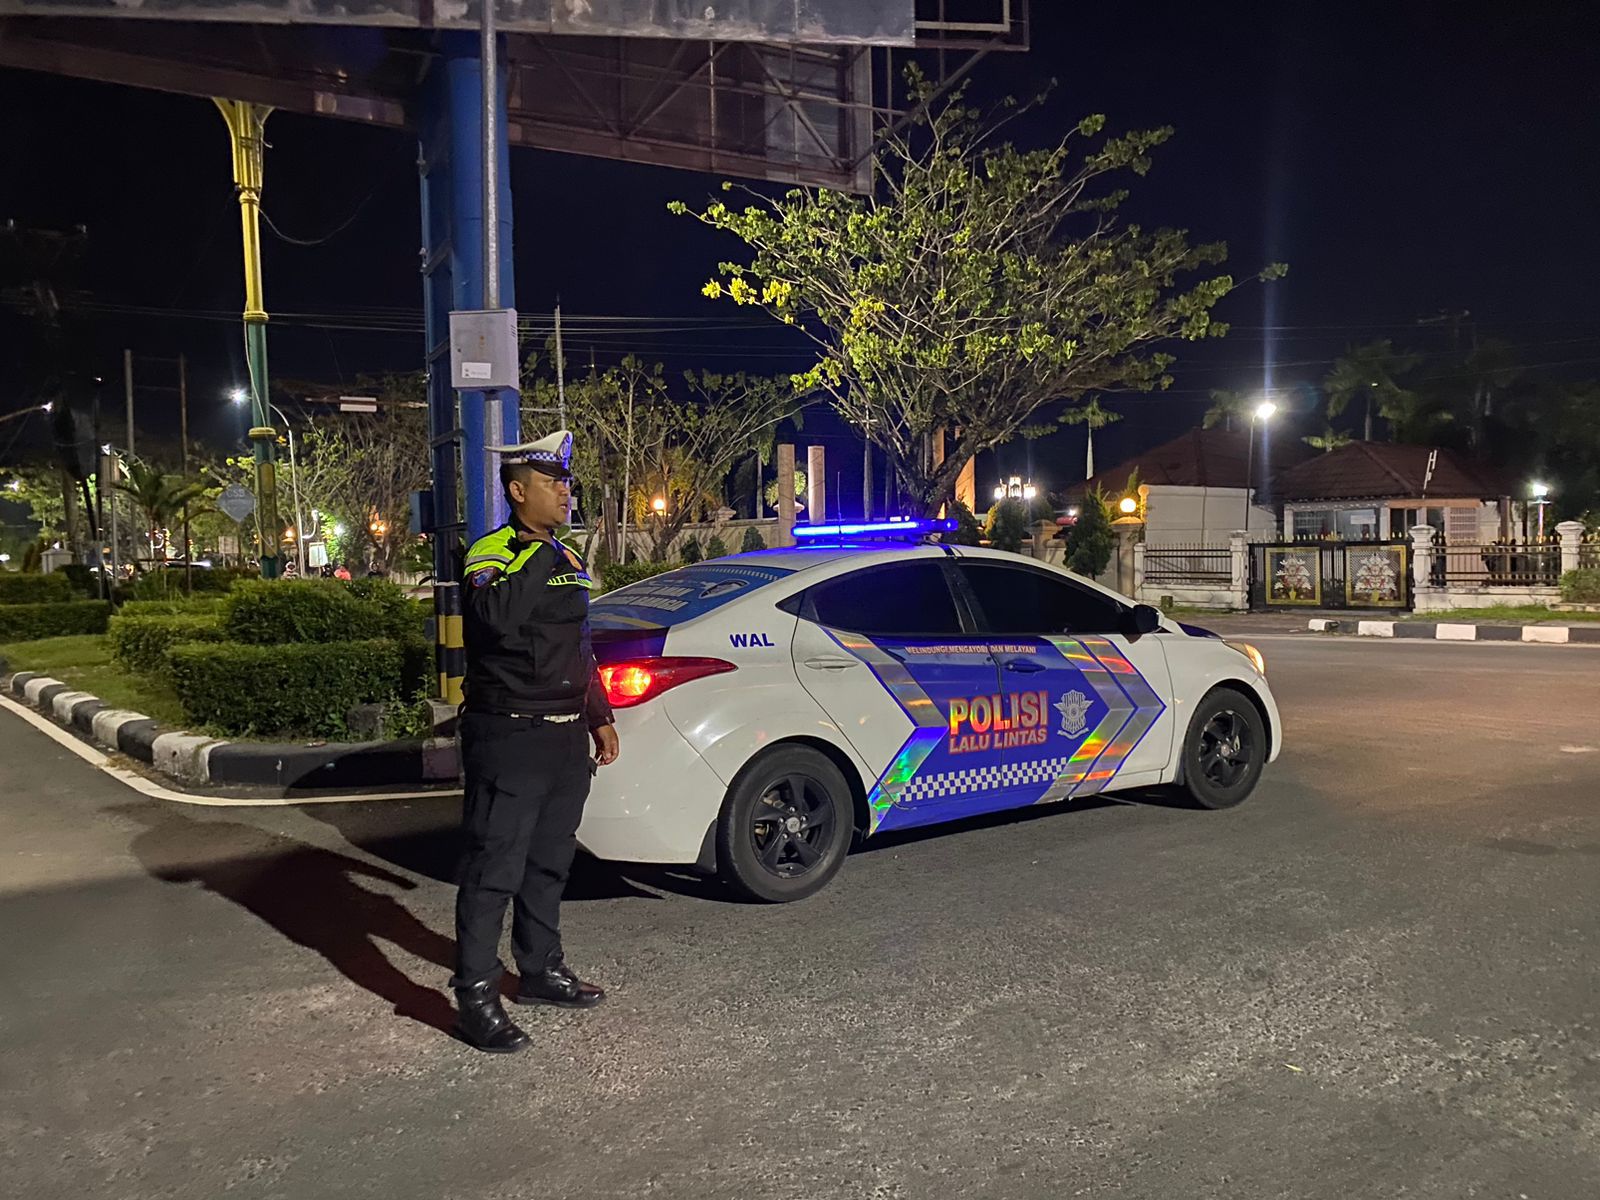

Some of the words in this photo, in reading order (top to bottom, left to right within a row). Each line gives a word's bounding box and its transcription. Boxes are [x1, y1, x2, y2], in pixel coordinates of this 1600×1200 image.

[729, 632, 775, 648] WAL
[1005, 644, 1037, 654] MELAYANI
[949, 690, 1049, 736] POLISI
[949, 734, 992, 755] LALU
[993, 727, 1048, 749] LINTAS
